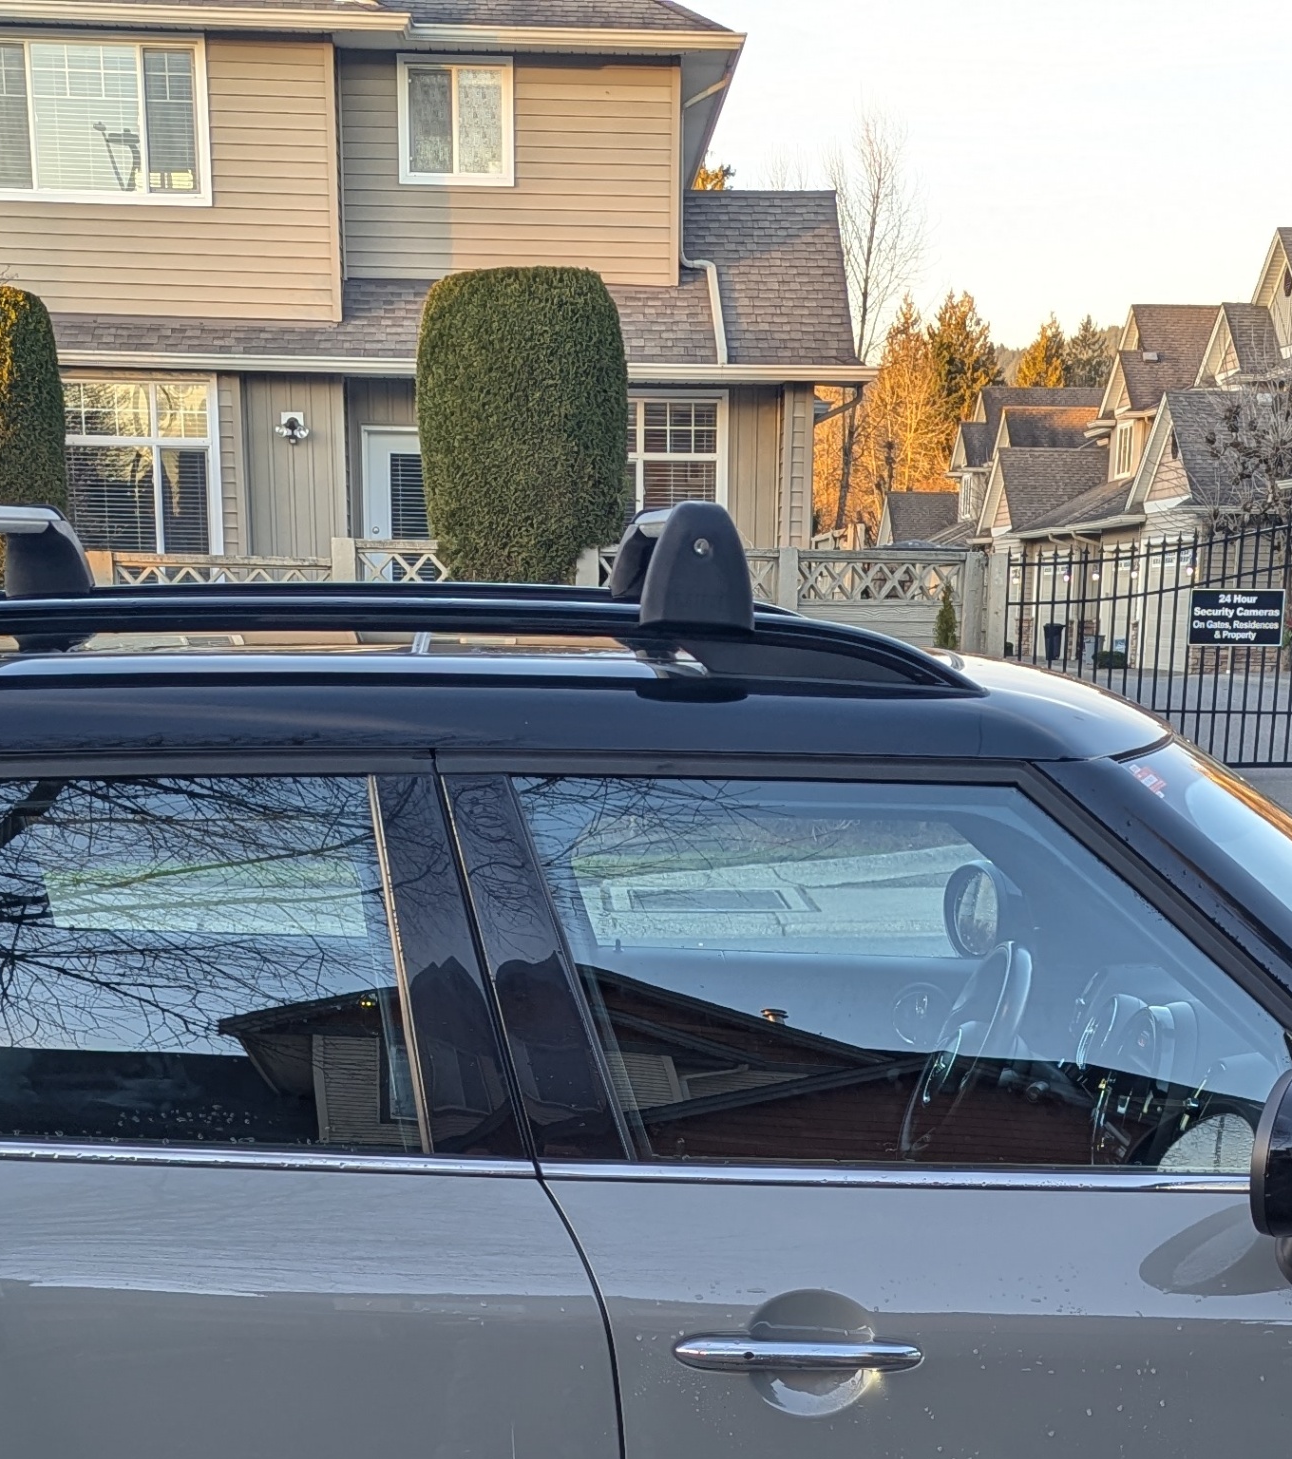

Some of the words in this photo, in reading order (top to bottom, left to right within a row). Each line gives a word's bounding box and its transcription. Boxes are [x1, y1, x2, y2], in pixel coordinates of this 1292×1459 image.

[1218, 594, 1231, 603] 24
[1233, 594, 1258, 604] Hour
[1194, 607, 1235, 618] Security
[1236, 607, 1280, 616] Cameras
[1193, 620, 1205, 628] On
[1206, 620, 1232, 630] Gates,
[1233, 620, 1279, 630] Residences
[1214, 630, 1221, 638] &
[1222, 630, 1256, 640] Property
